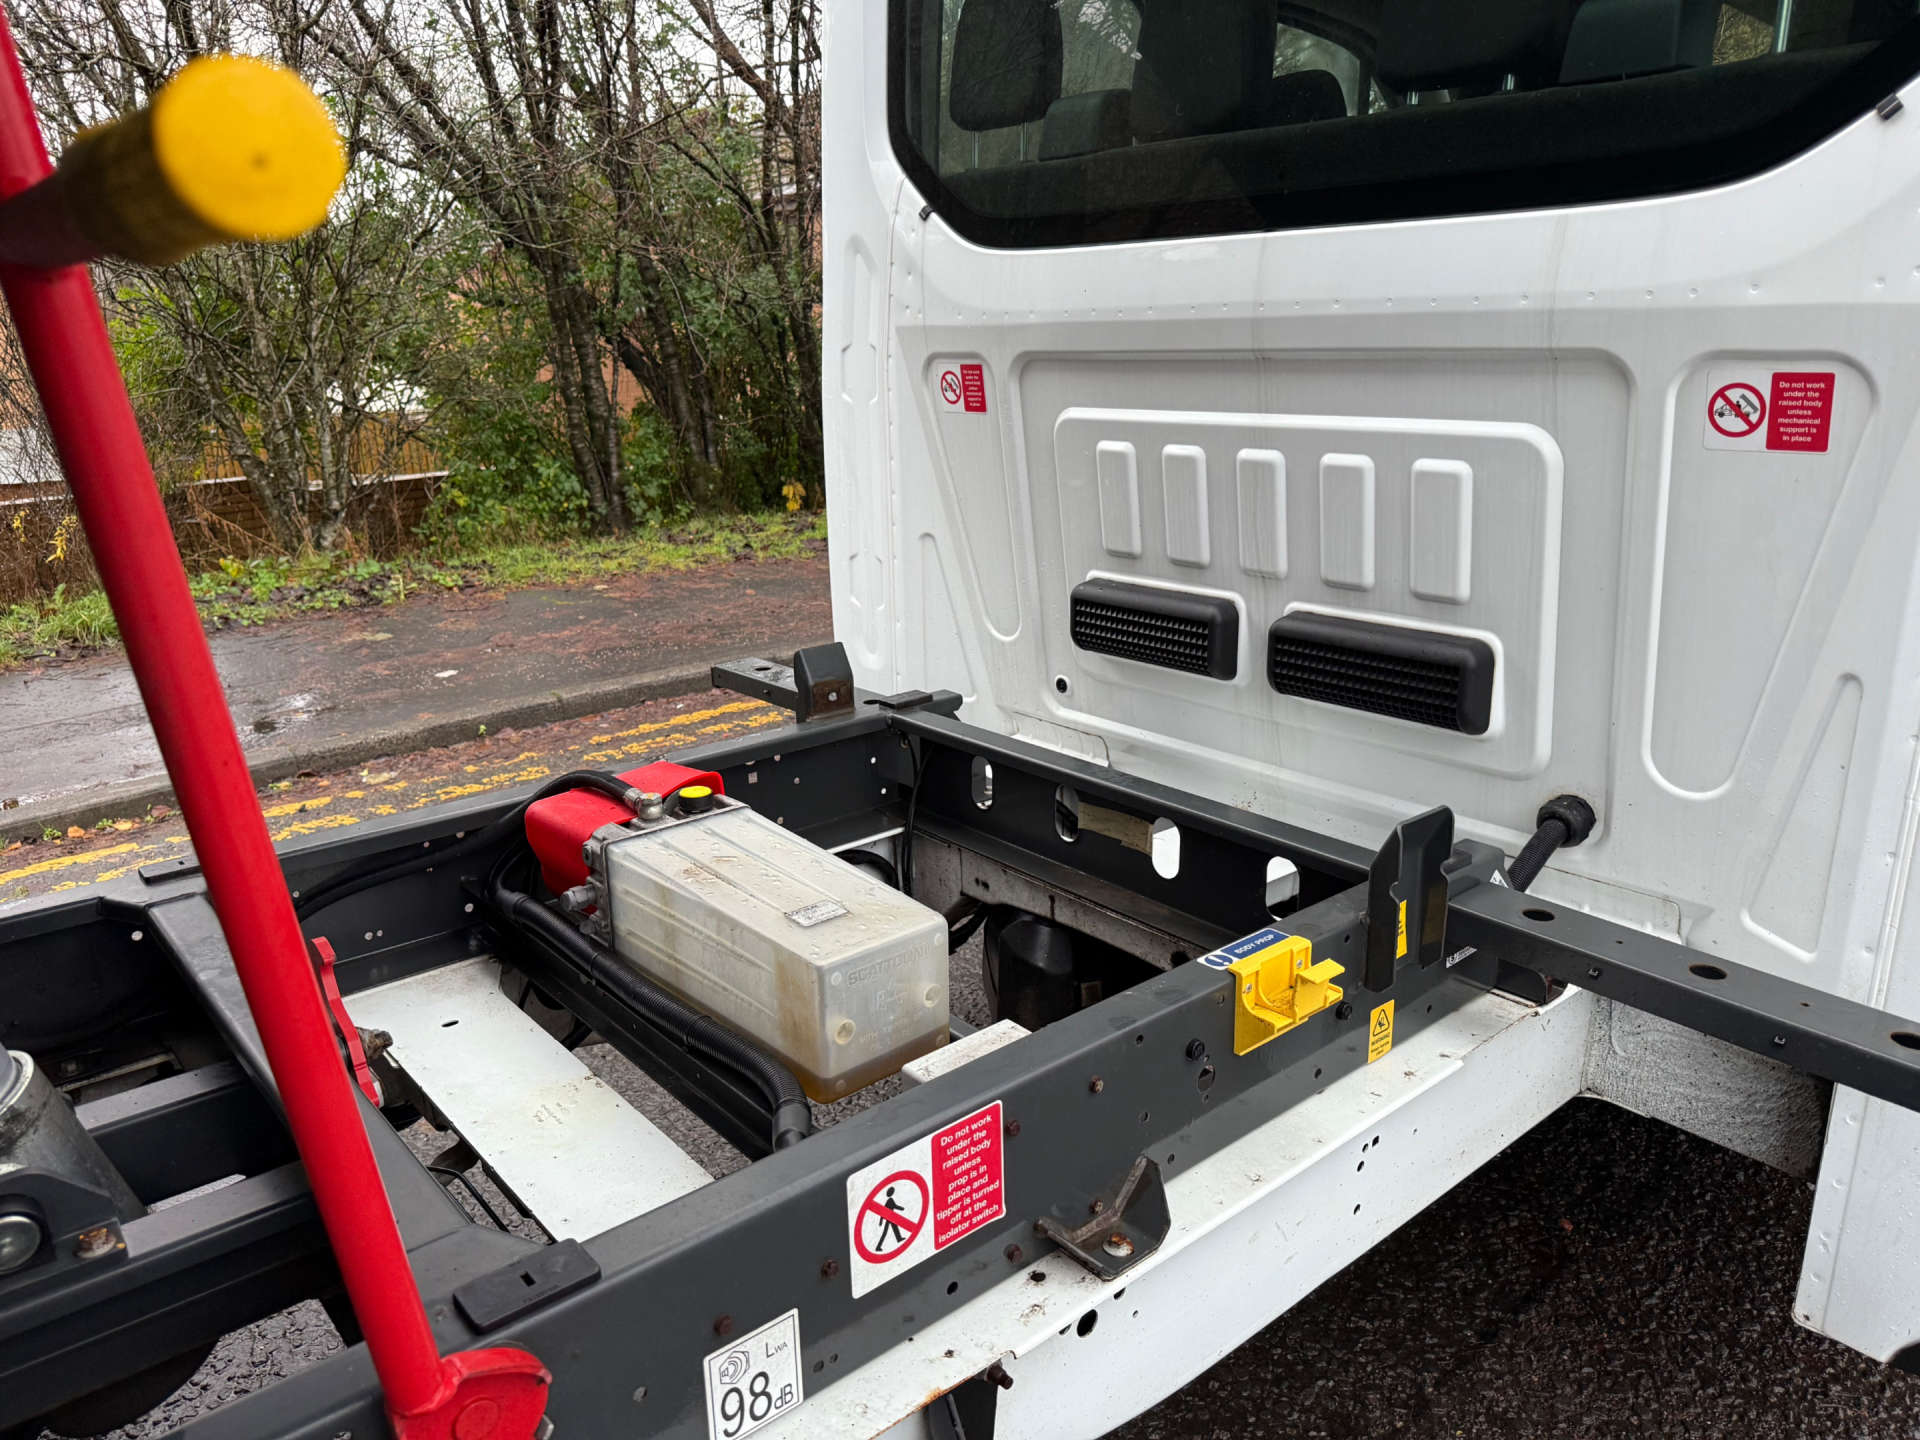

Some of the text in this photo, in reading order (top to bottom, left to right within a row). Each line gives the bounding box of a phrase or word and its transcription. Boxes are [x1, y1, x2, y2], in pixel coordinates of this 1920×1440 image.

[1803, 400, 1822, 408] body
[940, 1114, 992, 1147] Do not work
[946, 1130, 987, 1155] under the
[942, 1138, 991, 1170] raised body
[953, 1156, 981, 1176] unless
[948, 1164, 987, 1192] prop is in
[948, 1173, 988, 1205] place and
[936, 1179, 999, 1220] tipper is turned
[950, 1199, 987, 1224] off at the
[938, 1204, 999, 1243] isolator switch
[721, 1371, 794, 1437] 98 dB
